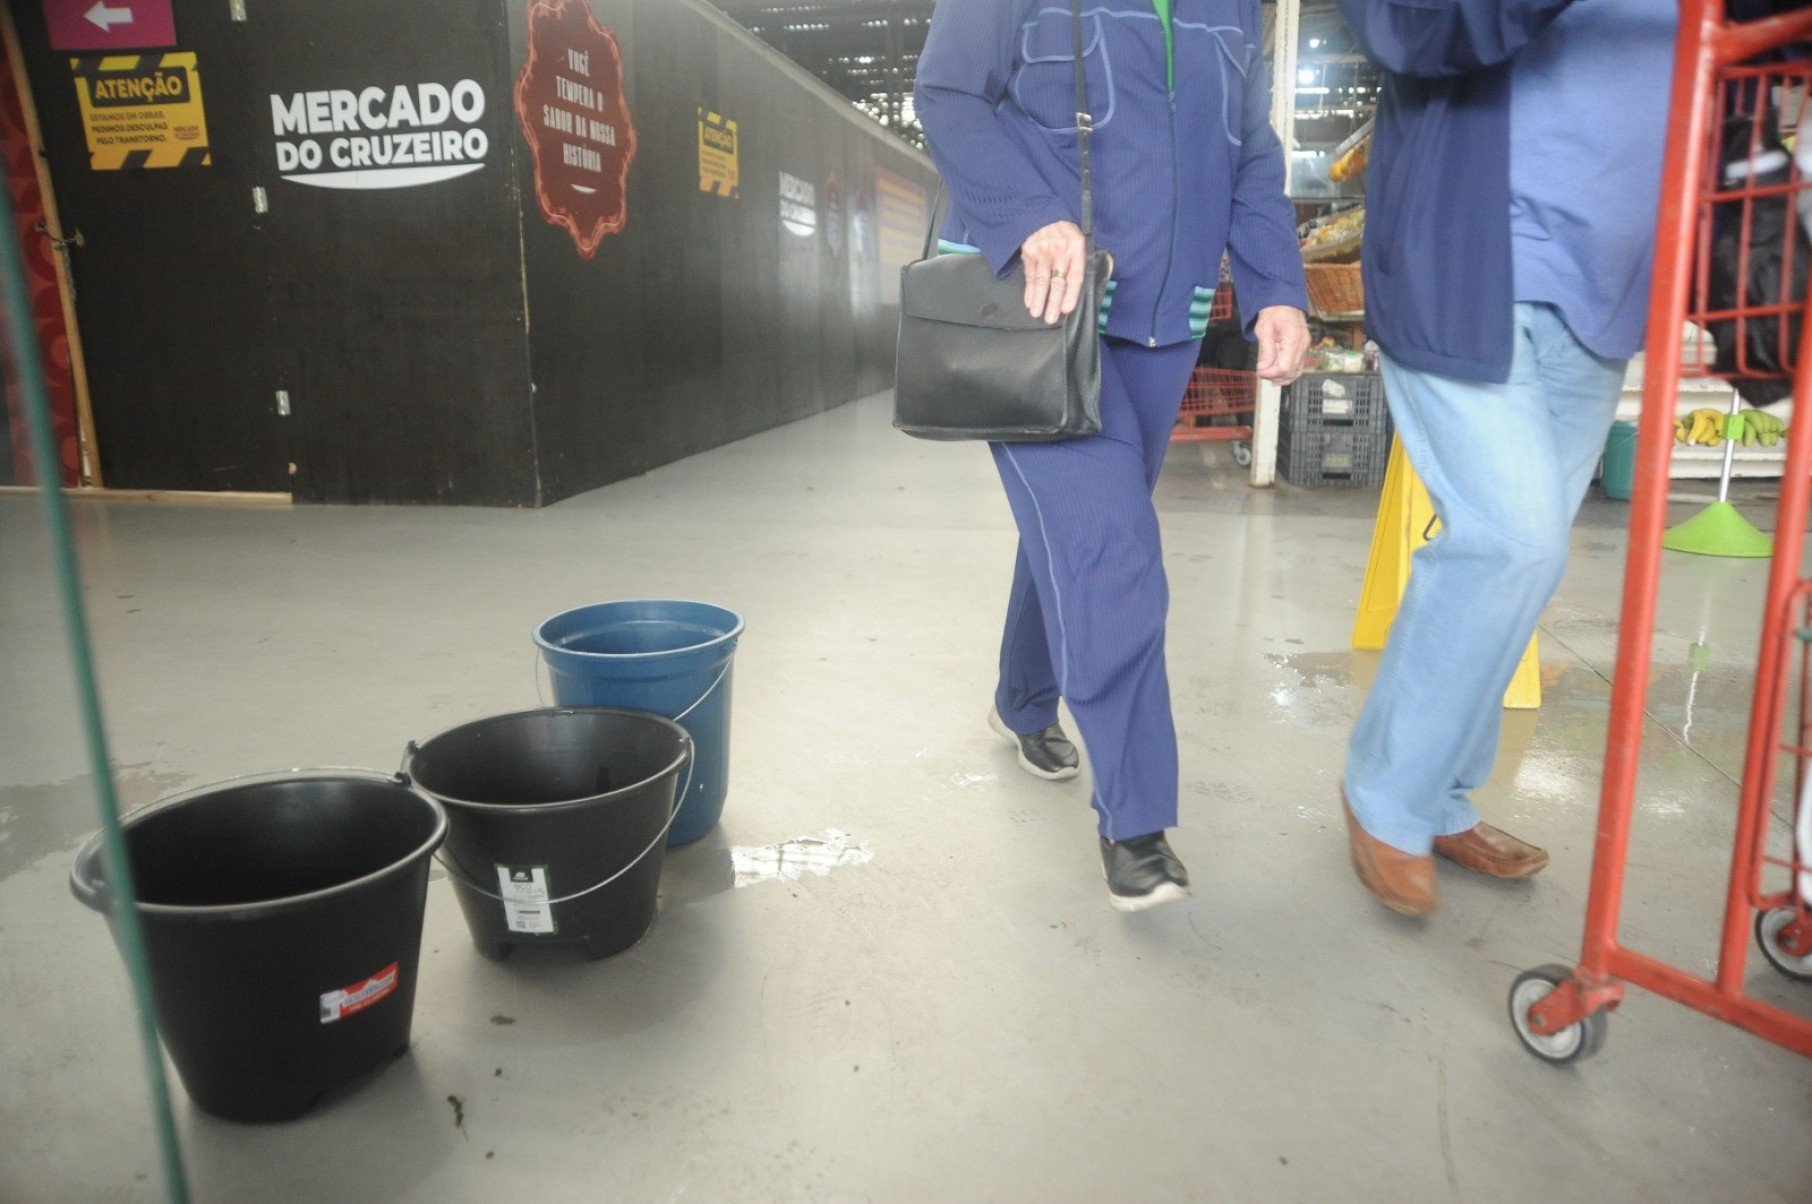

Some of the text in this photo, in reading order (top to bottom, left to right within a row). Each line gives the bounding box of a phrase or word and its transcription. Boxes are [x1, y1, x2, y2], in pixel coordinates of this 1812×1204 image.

[567, 48, 590, 77] VOCÊ
[95, 72, 182, 102] ATENÇÃO
[556, 76, 604, 112] TEMPERA O
[270, 79, 485, 136] MERCADO
[543, 104, 616, 147] SABOR DA NOSSA
[275, 128, 489, 171] DO CRUZEIRO
[562, 143, 603, 173] HISTÓRIA
